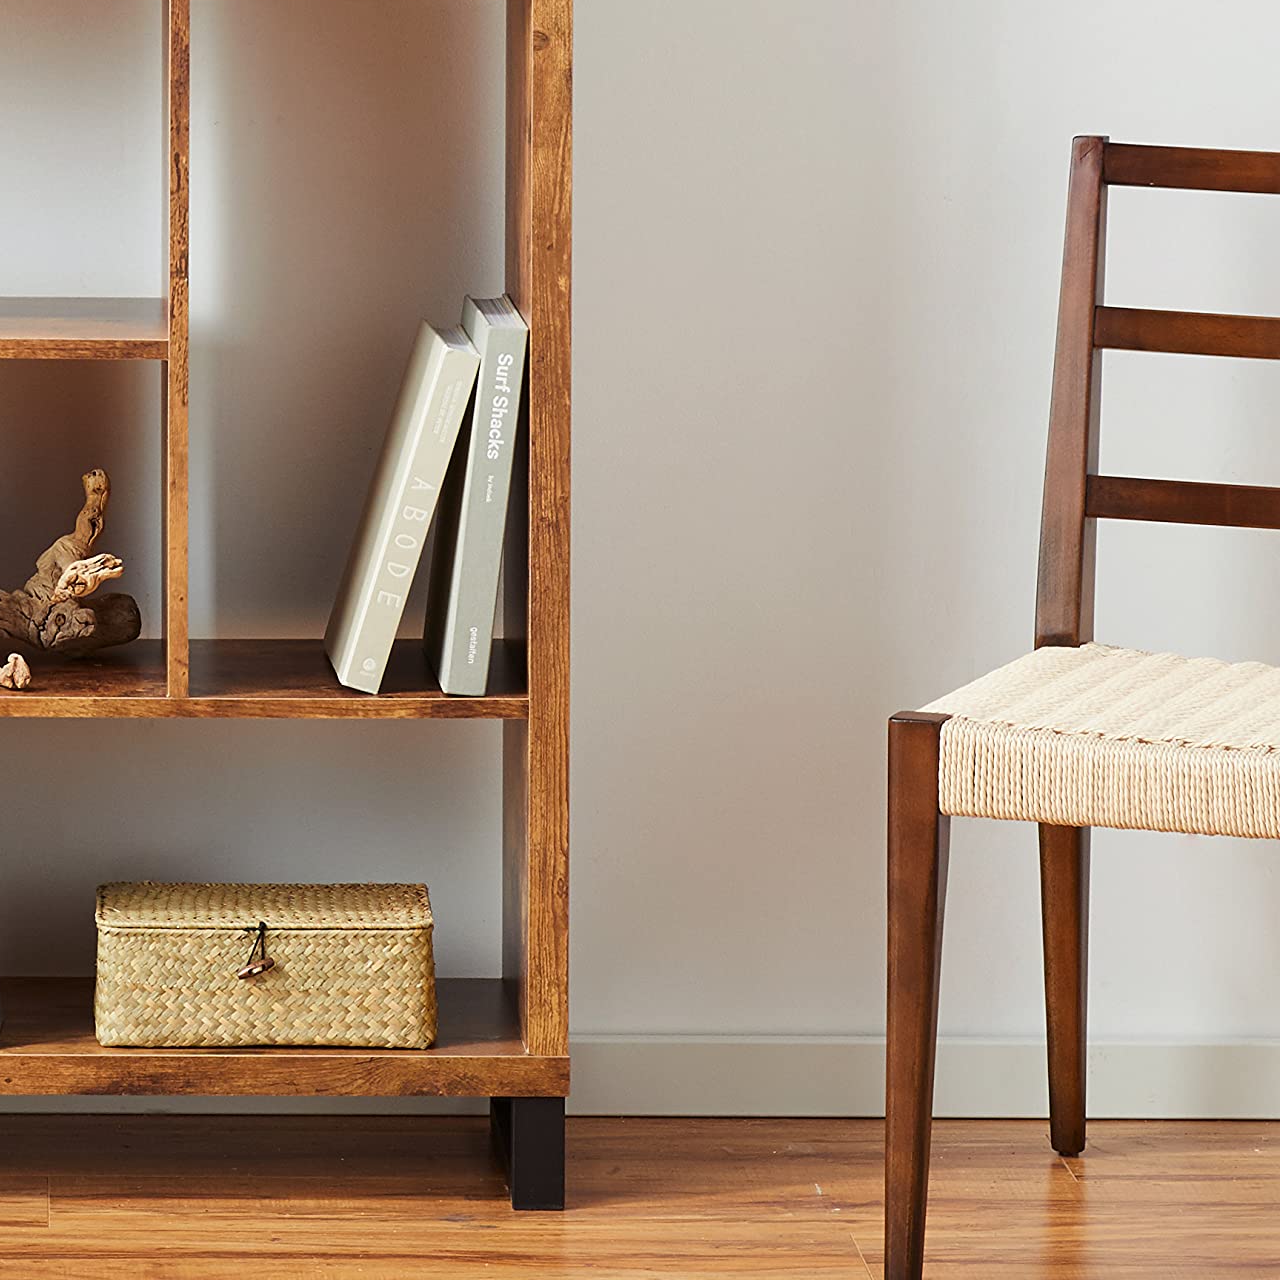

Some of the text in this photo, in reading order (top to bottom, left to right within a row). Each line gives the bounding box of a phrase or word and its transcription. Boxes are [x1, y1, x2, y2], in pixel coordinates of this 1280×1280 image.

[487, 353, 514, 460] Surf Shacks
[377, 476, 436, 608] ABODE
[467, 626, 478, 664] gestalten
